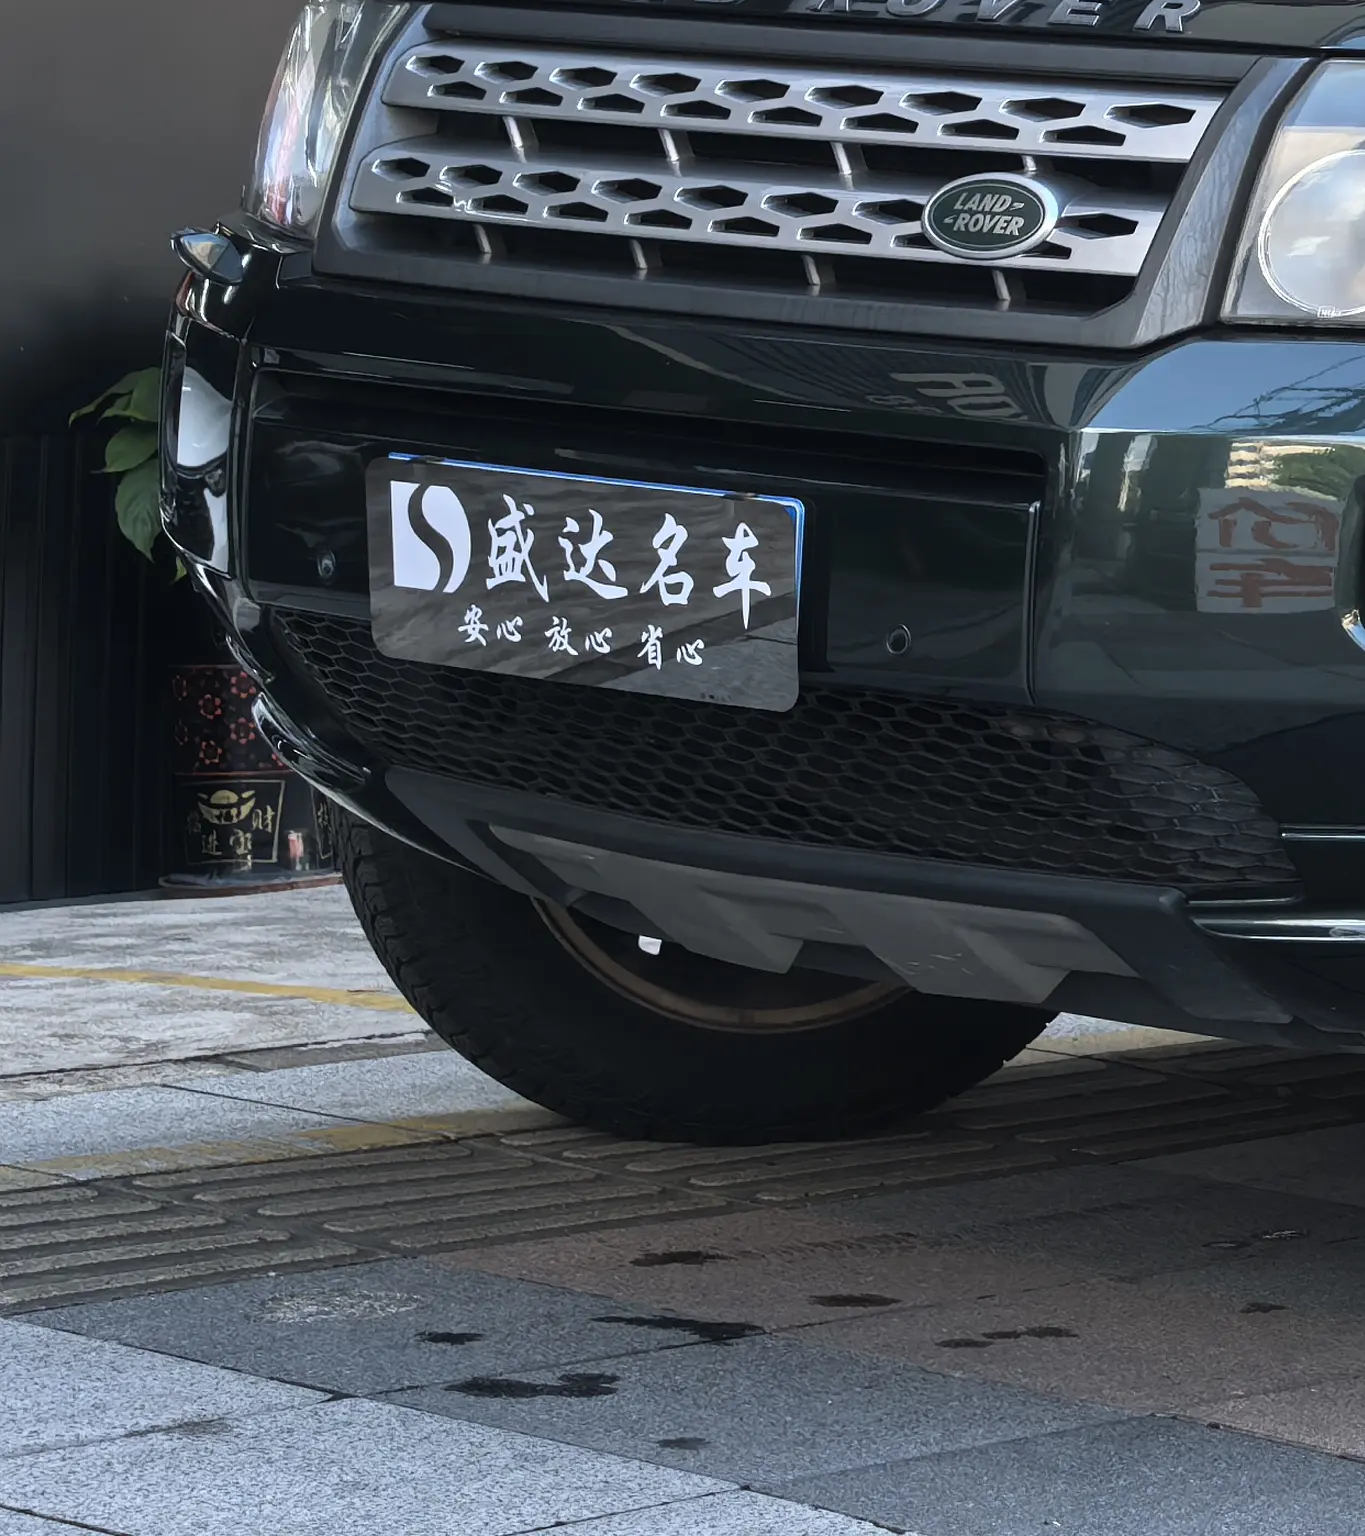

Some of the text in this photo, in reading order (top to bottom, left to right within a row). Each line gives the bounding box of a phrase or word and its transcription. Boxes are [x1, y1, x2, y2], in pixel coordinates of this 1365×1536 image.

[953, 191, 1014, 212] LAND
[952, 213, 1025, 236] ROVER
[486, 493, 772, 630] 盛达名车
[458, 604, 706, 670] 安心 放心 省心
